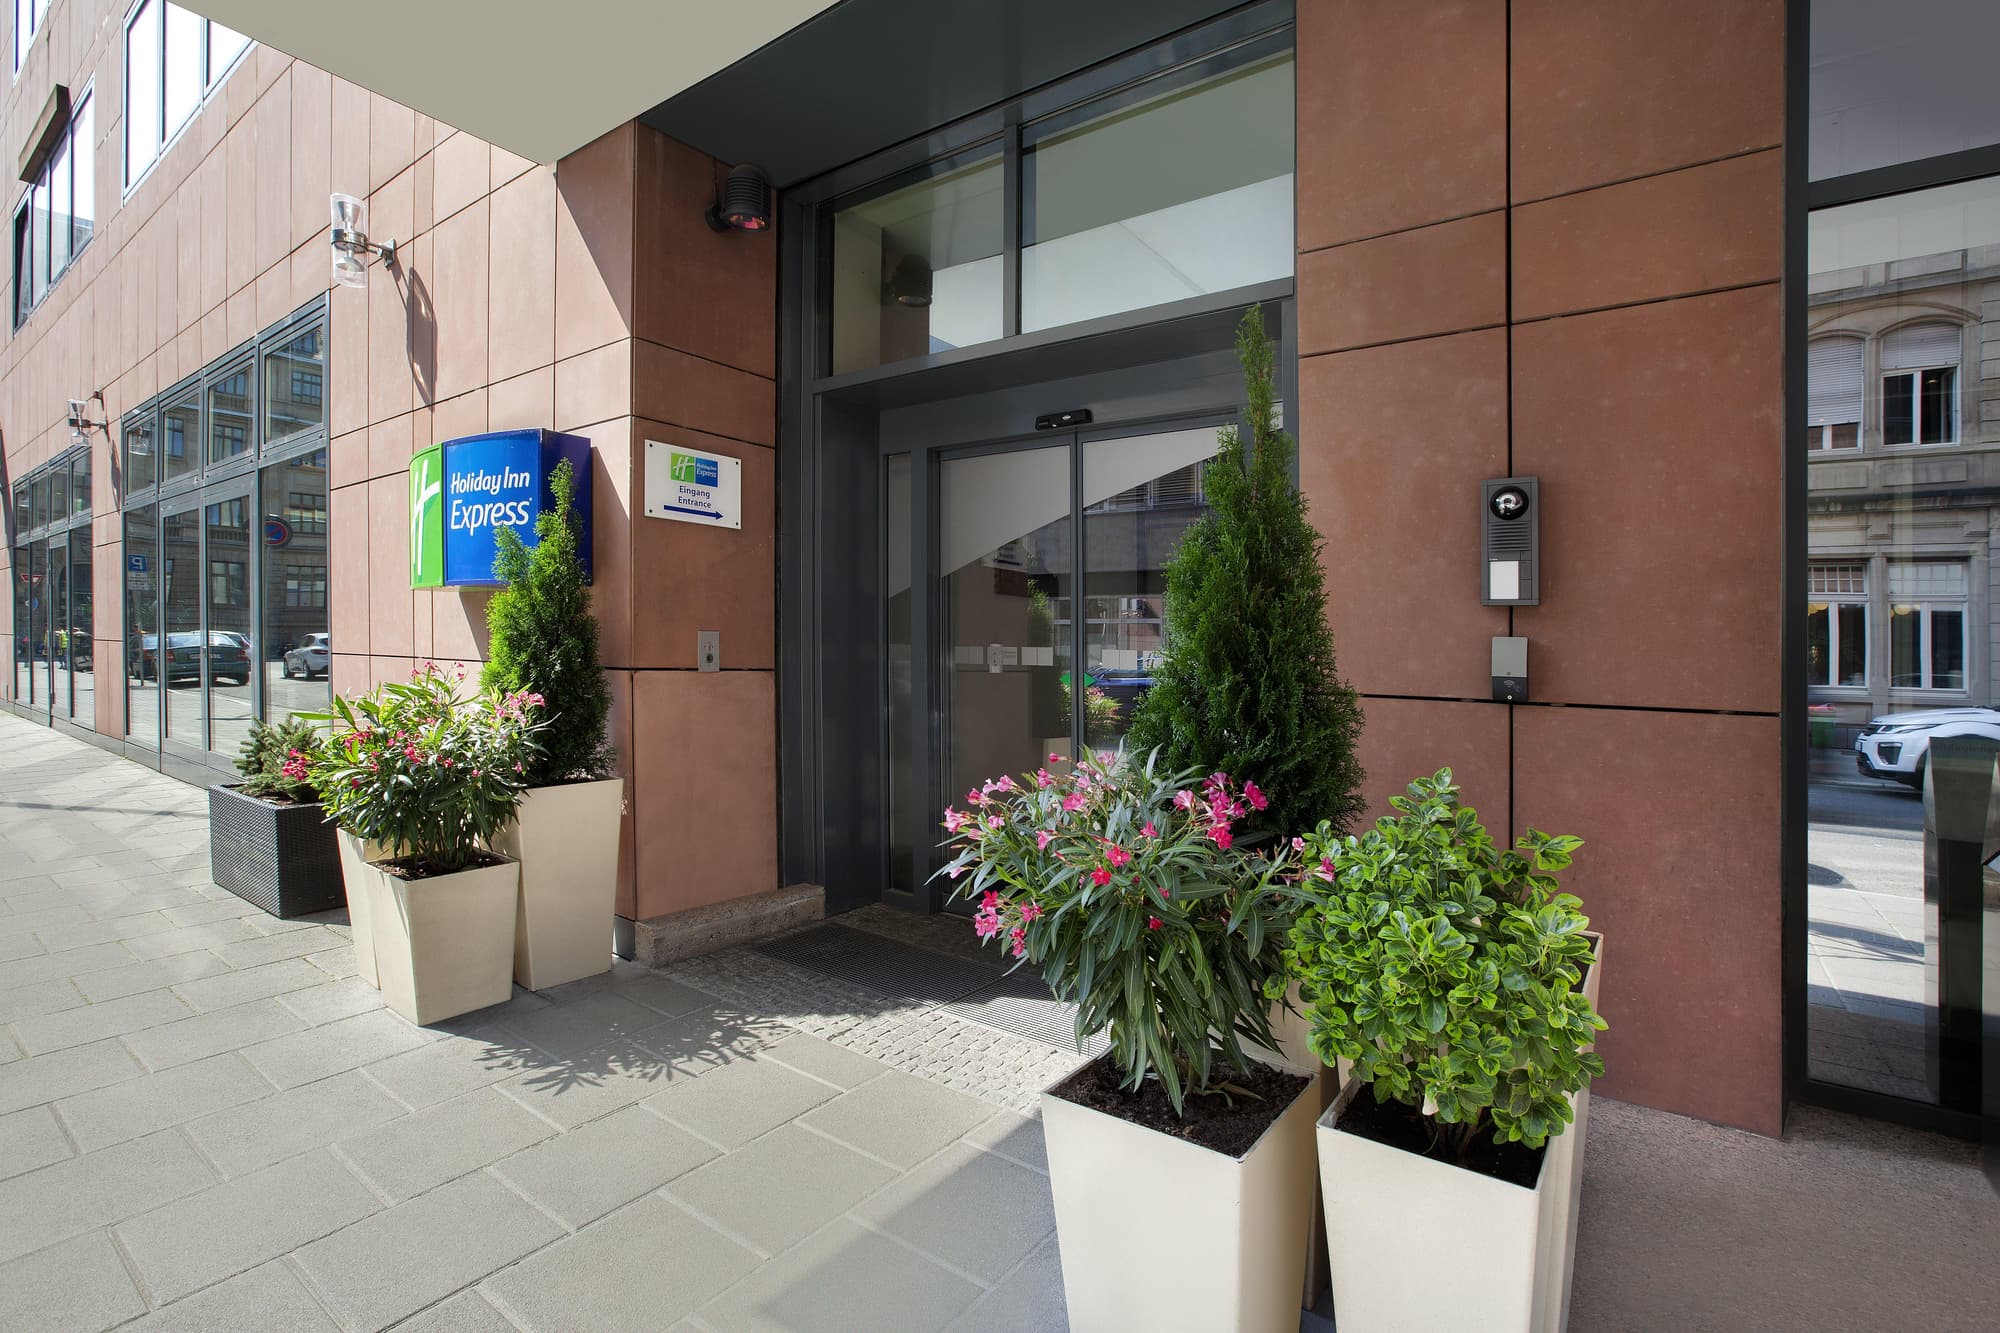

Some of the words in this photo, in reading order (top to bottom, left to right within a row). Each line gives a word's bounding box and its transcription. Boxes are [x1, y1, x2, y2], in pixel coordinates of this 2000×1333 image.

[450, 469, 501, 495] Holiday
[503, 466, 530, 488] Inn
[696, 469, 717, 478] Express
[679, 485, 711, 499] Eingang
[678, 496, 712, 509] Entrance
[450, 499, 531, 537] Express
